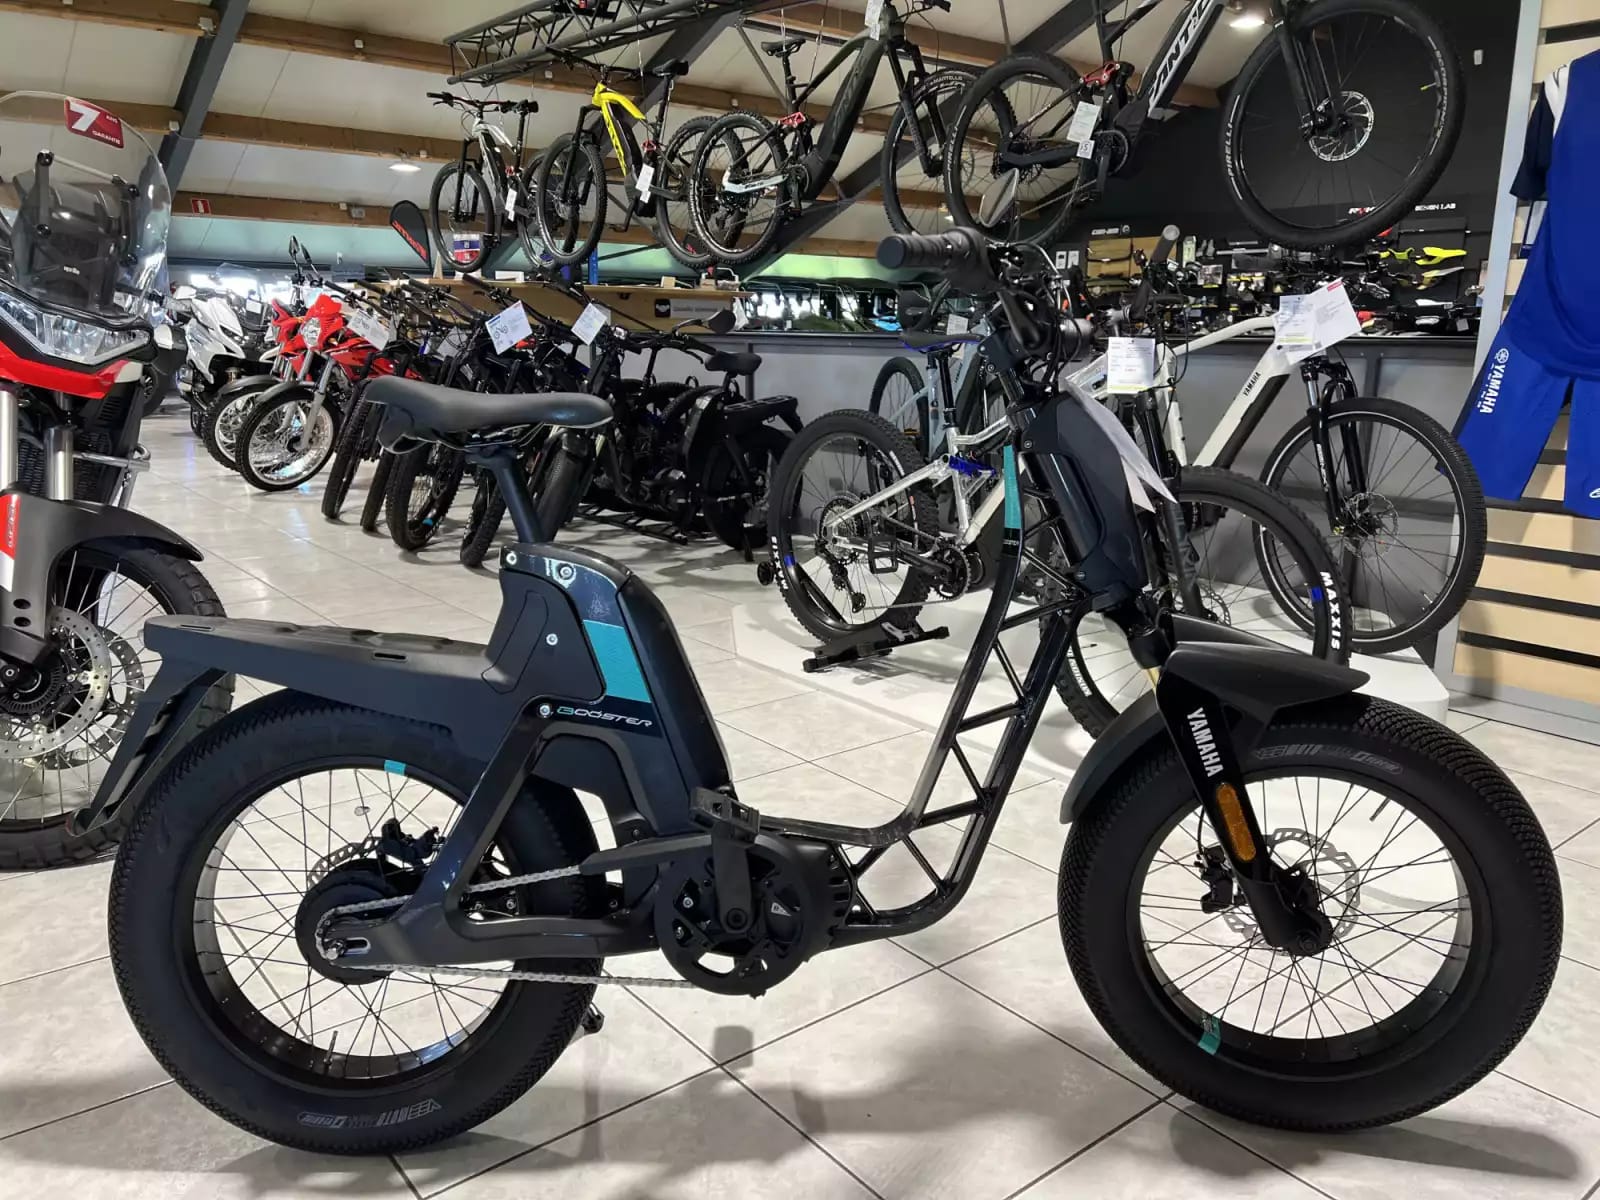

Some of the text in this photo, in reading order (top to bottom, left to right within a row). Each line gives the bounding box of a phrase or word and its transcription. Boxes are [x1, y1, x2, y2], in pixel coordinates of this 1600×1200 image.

[69, 101, 101, 131] 7
[1225, 122, 1235, 177] PIRELLI
[1242, 371, 1261, 397] YAMAHA
[1480, 364, 1506, 413] YAMAHA
[1320, 571, 1341, 650] MAXXIS
[556, 706, 653, 728] BOOSTER
[1187, 706, 1224, 778] YAMAHA
